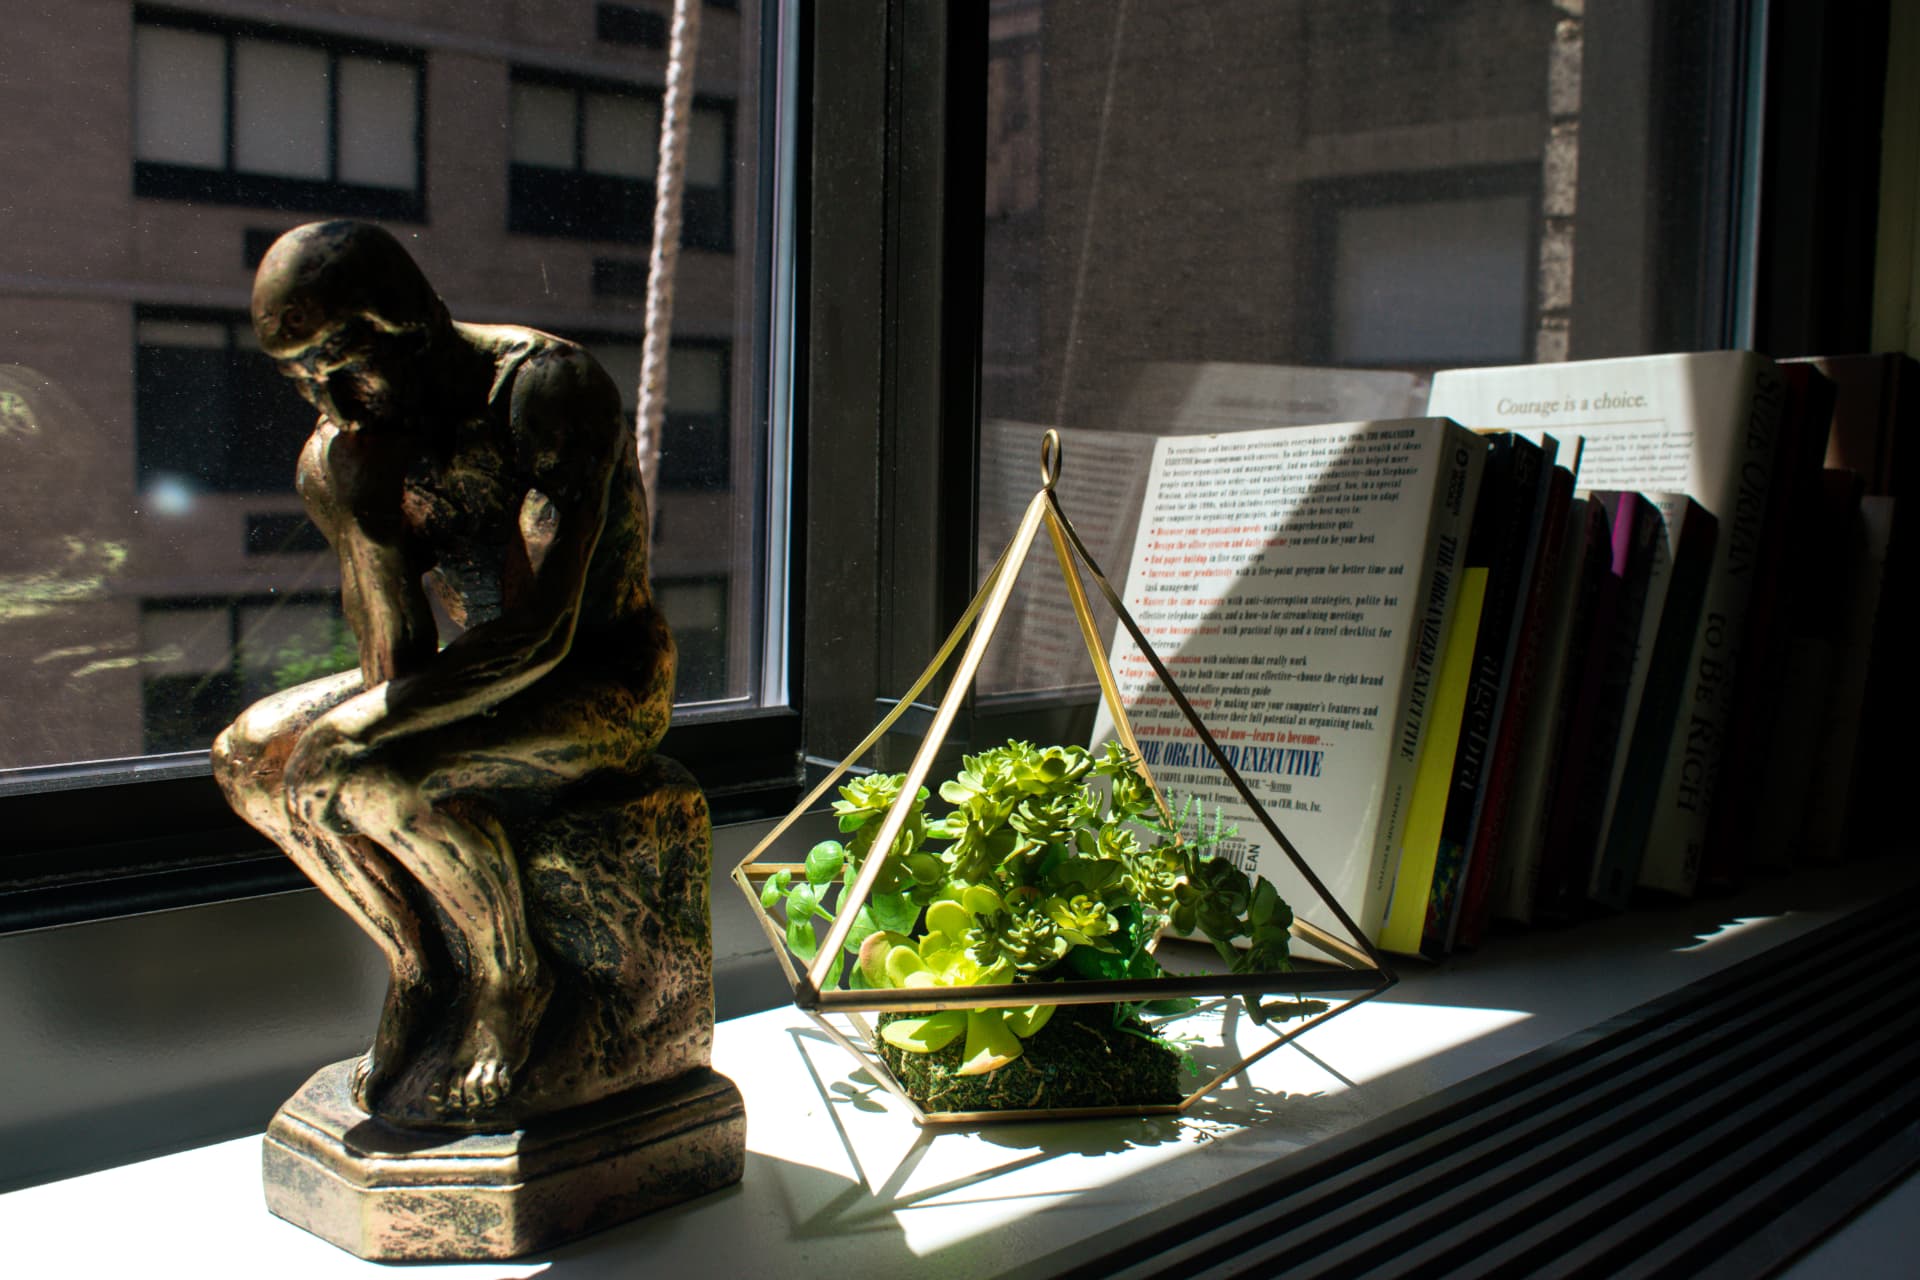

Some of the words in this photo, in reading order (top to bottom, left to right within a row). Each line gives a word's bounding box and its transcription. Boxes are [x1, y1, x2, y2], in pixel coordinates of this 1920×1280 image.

[1497, 397, 1560, 418] Courage
[1563, 393, 1577, 412] is
[1580, 398, 1590, 412] a
[1592, 389, 1649, 411] choice.
[1368, 443, 1391, 452] wealth
[1393, 442, 1400, 451] of
[1403, 441, 1421, 450] ideas
[1366, 455, 1389, 466] helped
[1382, 466, 1418, 477] Stephanie
[1376, 479, 1402, 490] special
[1326, 494, 1342, 503] need
[1352, 493, 1369, 502] know
[1371, 493, 1378, 501] to
[1380, 492, 1399, 502] adapt
[1319, 507, 1333, 515] best
[1335, 507, 1350, 516] ways
[1287, 537, 1301, 548] you
[1303, 535, 1320, 545] need
[1321, 536, 1329, 544] to
[1330, 534, 1340, 546] be
[1340, 536, 1357, 547] your
[1358, 533, 1375, 544] best
[1437, 533, 1458, 573] THE
[1236, 566, 1252, 577] with
[1258, 565, 1293, 578] five-point
[1294, 567, 1325, 578] program
[1328, 563, 1340, 574] for
[1341, 564, 1365, 574] better
[1368, 565, 1386, 574] time
[1388, 563, 1404, 575] and
[1226, 595, 1243, 607] with
[1245, 596, 1308, 605] anti-interruption
[1310, 595, 1352, 606] strategies,
[1355, 594, 1381, 607] polite
[1384, 595, 1398, 607] but
[1225, 608, 1239, 620] and
[1245, 610, 1269, 620] how-to
[1270, 610, 1281, 620] for
[1282, 610, 1328, 622] streamlining
[1329, 611, 1364, 622] meetings
[1222, 625, 1238, 635] with
[1239, 625, 1272, 638] practical
[1274, 626, 1288, 638] tips
[1290, 625, 1304, 635] and
[1314, 625, 1338, 636] travel
[1340, 626, 1376, 637] checklist
[1379, 627, 1392, 638] for
[1203, 654, 1218, 664] with
[1219, 654, 1249, 664] solutions
[1251, 654, 1265, 665] that
[1266, 655, 1287, 668] really
[1290, 656, 1307, 666] work
[1188, 669, 1197, 679] be
[1198, 669, 1213, 679] both
[1214, 670, 1229, 679] time
[1231, 670, 1244, 680] and
[1245, 672, 1261, 680] cost
[1323, 672, 1336, 683] the
[1338, 673, 1358, 686] right
[1360, 674, 1384, 686] brand
[1219, 685, 1250, 696] products
[1251, 686, 1271, 698] guide
[1214, 697, 1222, 709] by
[1224, 698, 1248, 710] making
[1251, 701, 1266, 709] sure
[1267, 702, 1284, 712] your
[1285, 702, 1325, 712] computer's
[1328, 702, 1360, 715] features
[1362, 705, 1379, 716] and
[1230, 712, 1248, 722] their
[1249, 712, 1264, 724] full
[1263, 715, 1297, 725] potential
[1298, 717, 1307, 725] as
[1308, 718, 1350, 731] organizing
[1352, 720, 1374, 731] tools.
[1459, 655, 1499, 792] algebra
[1132, 721, 1157, 736] Learn
[1156, 724, 1173, 736] how
[1172, 726, 1183, 737] to
[1277, 731, 1286, 743] to
[1137, 739, 1164, 766] THE
[1238, 746, 1323, 779] EXECUTIVE
[1679, 714, 1713, 815] RICH
[1245, 844, 1260, 872] EAN
